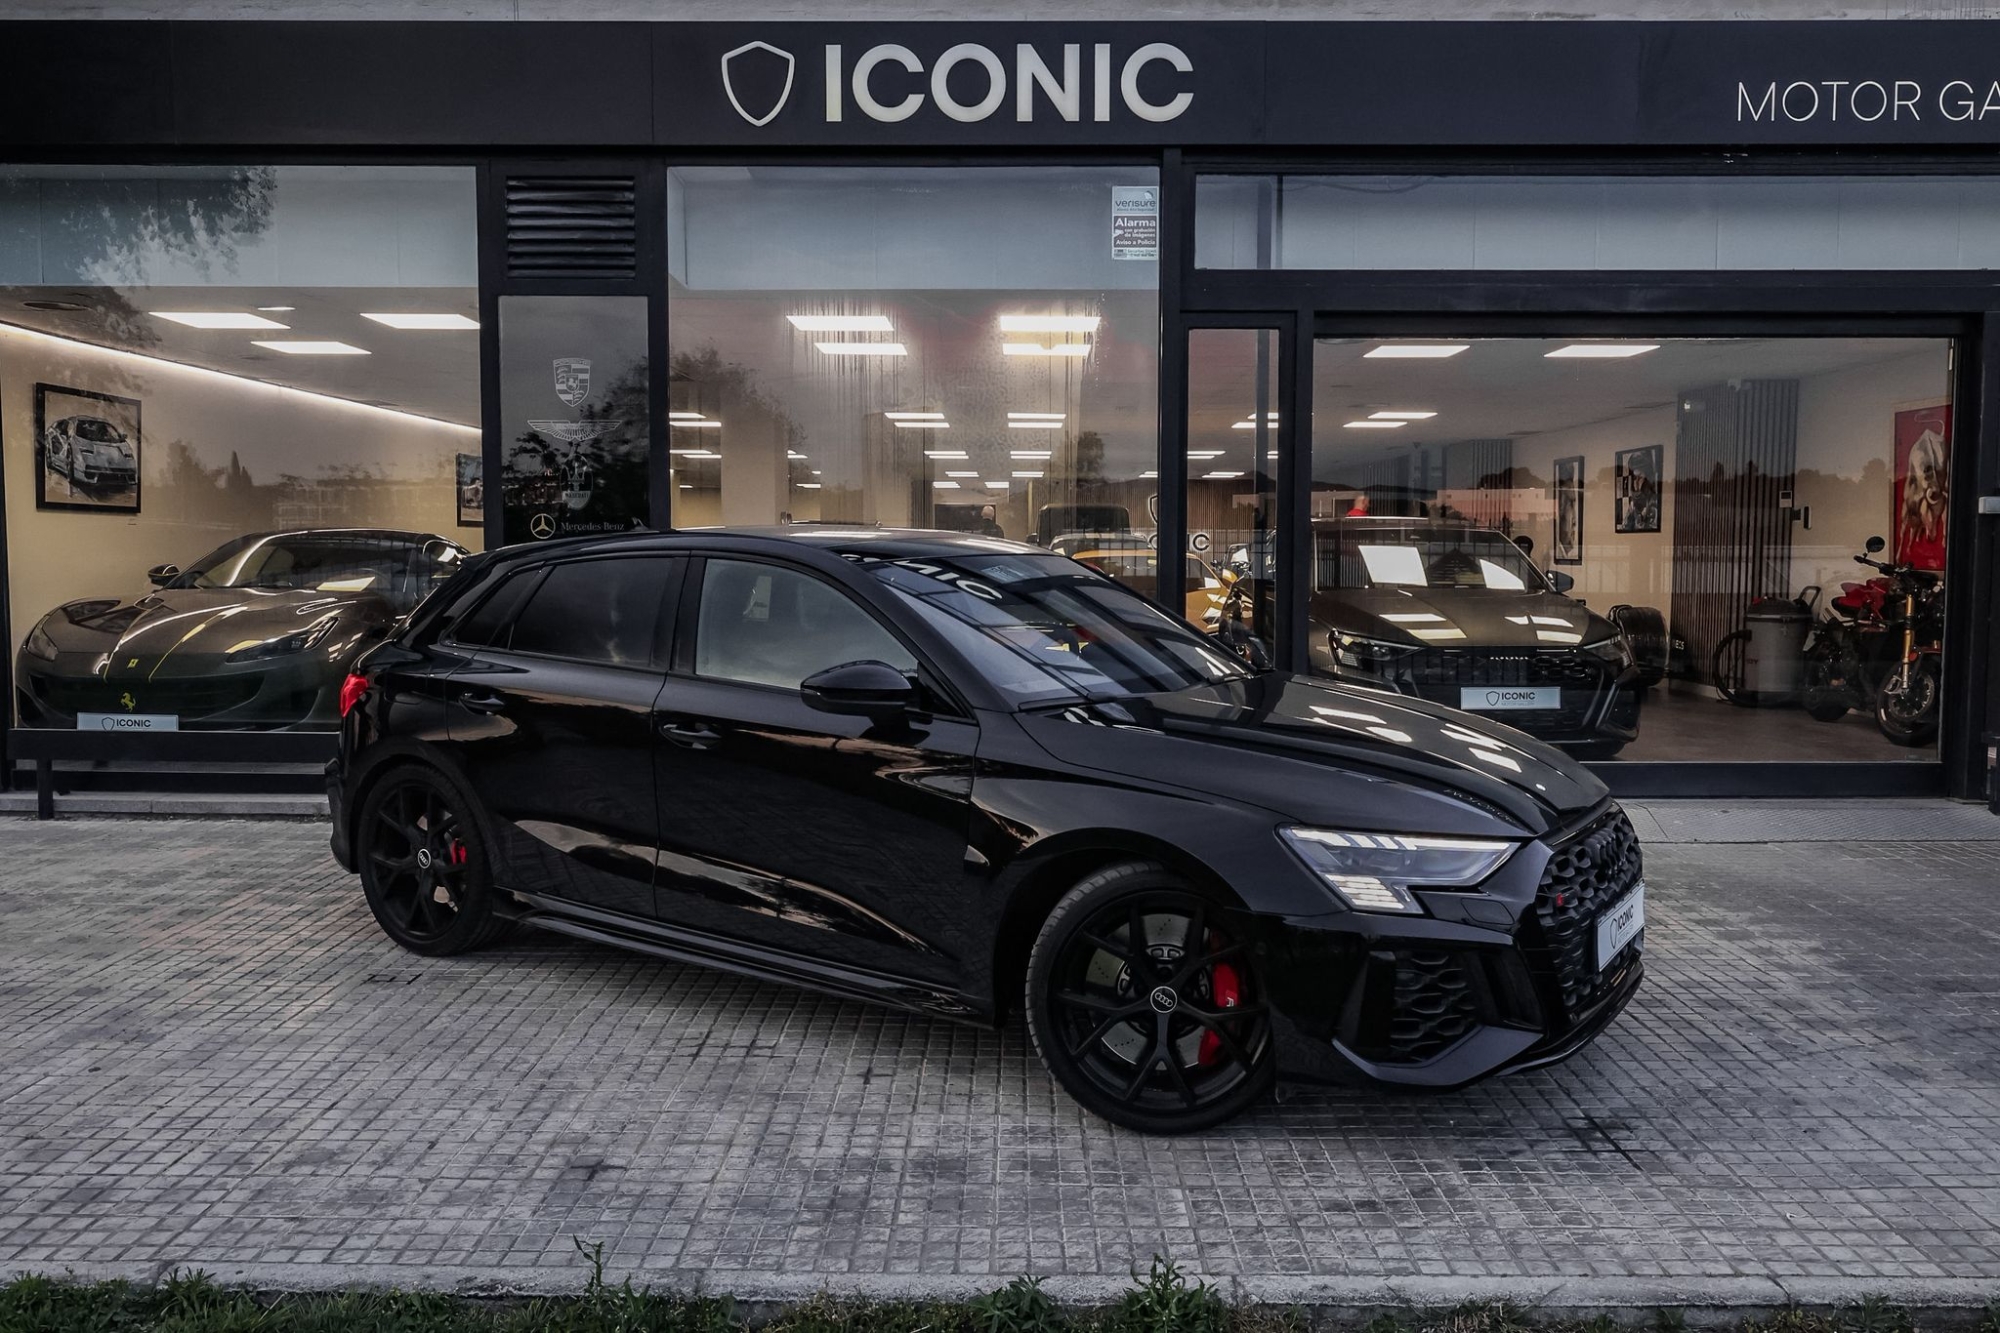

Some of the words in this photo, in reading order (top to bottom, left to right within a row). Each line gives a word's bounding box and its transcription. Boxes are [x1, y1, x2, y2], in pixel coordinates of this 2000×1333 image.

[825, 43, 1194, 122] ICONIC
[1737, 81, 1921, 121] MOTOR
[1939, 80, 2000, 121] GA
[1115, 200, 1156, 208] verisure
[1115, 217, 1156, 227] Alarma
[1501, 691, 1536, 701] ICONIC
[116, 719, 152, 728] ICONIC
[1617, 903, 1634, 932] ICONIC
